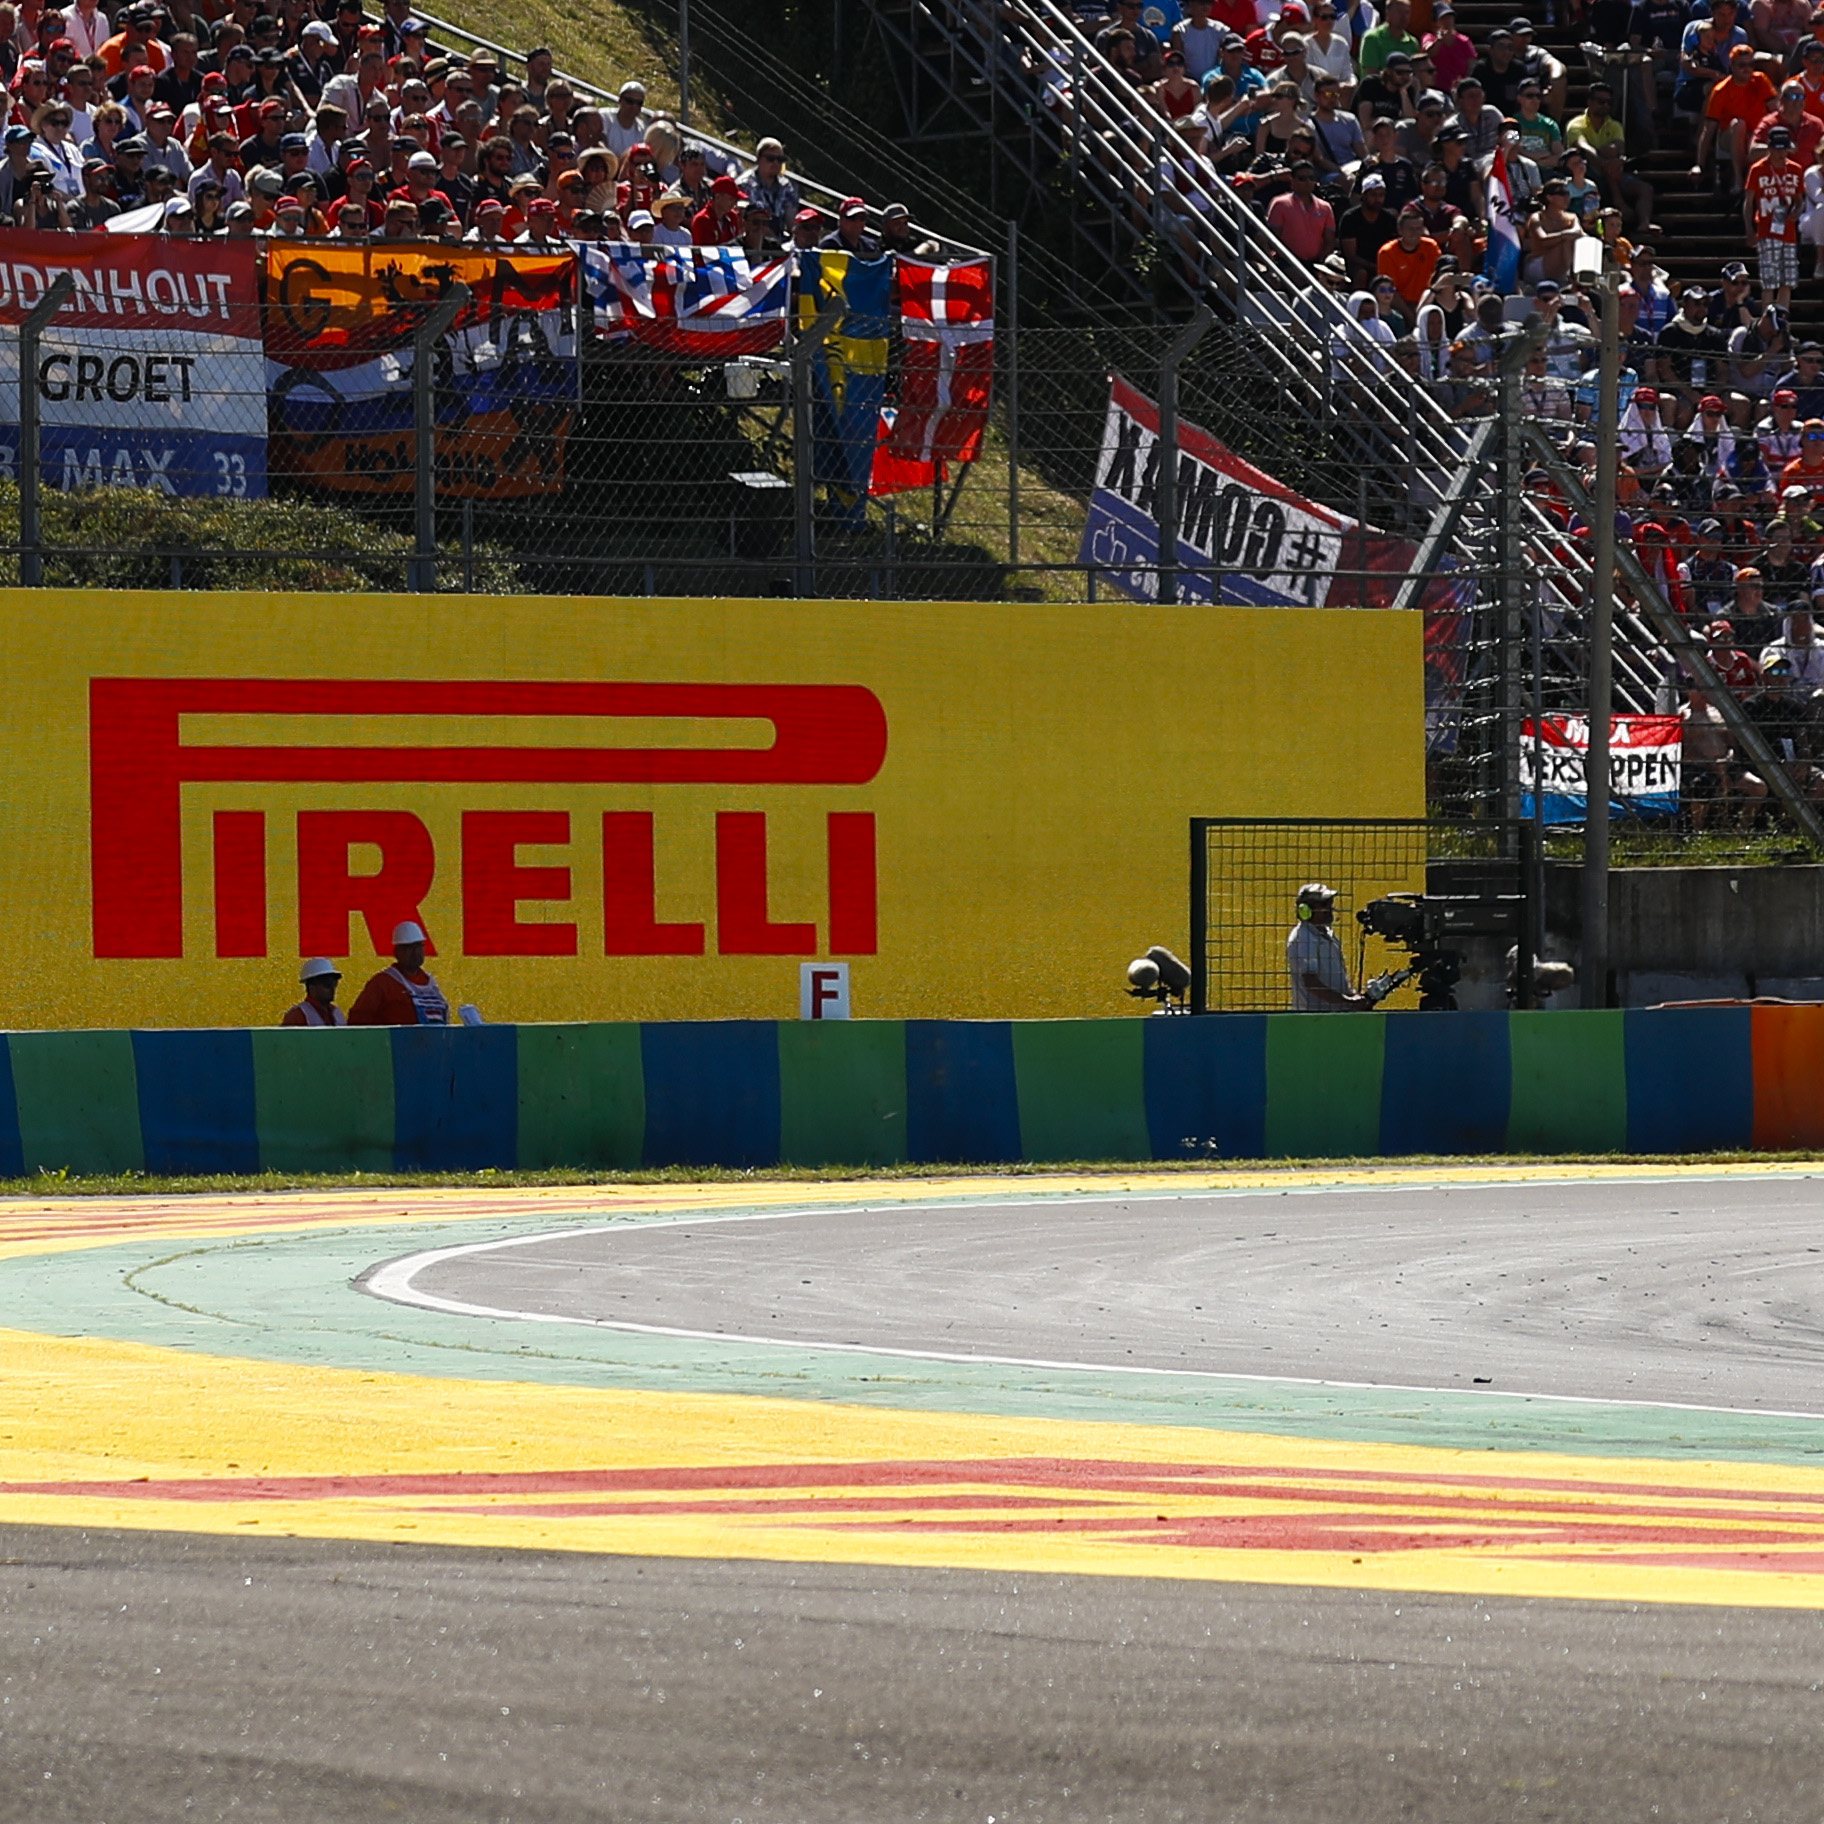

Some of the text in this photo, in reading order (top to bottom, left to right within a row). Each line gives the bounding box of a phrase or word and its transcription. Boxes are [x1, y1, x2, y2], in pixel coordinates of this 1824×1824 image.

[38, 354, 195, 403] GROET
[61, 448, 177, 496] MAX
[212, 451, 247, 497] 33
[88, 677, 888, 959] PIRELLI
[811, 970, 840, 1020] F
